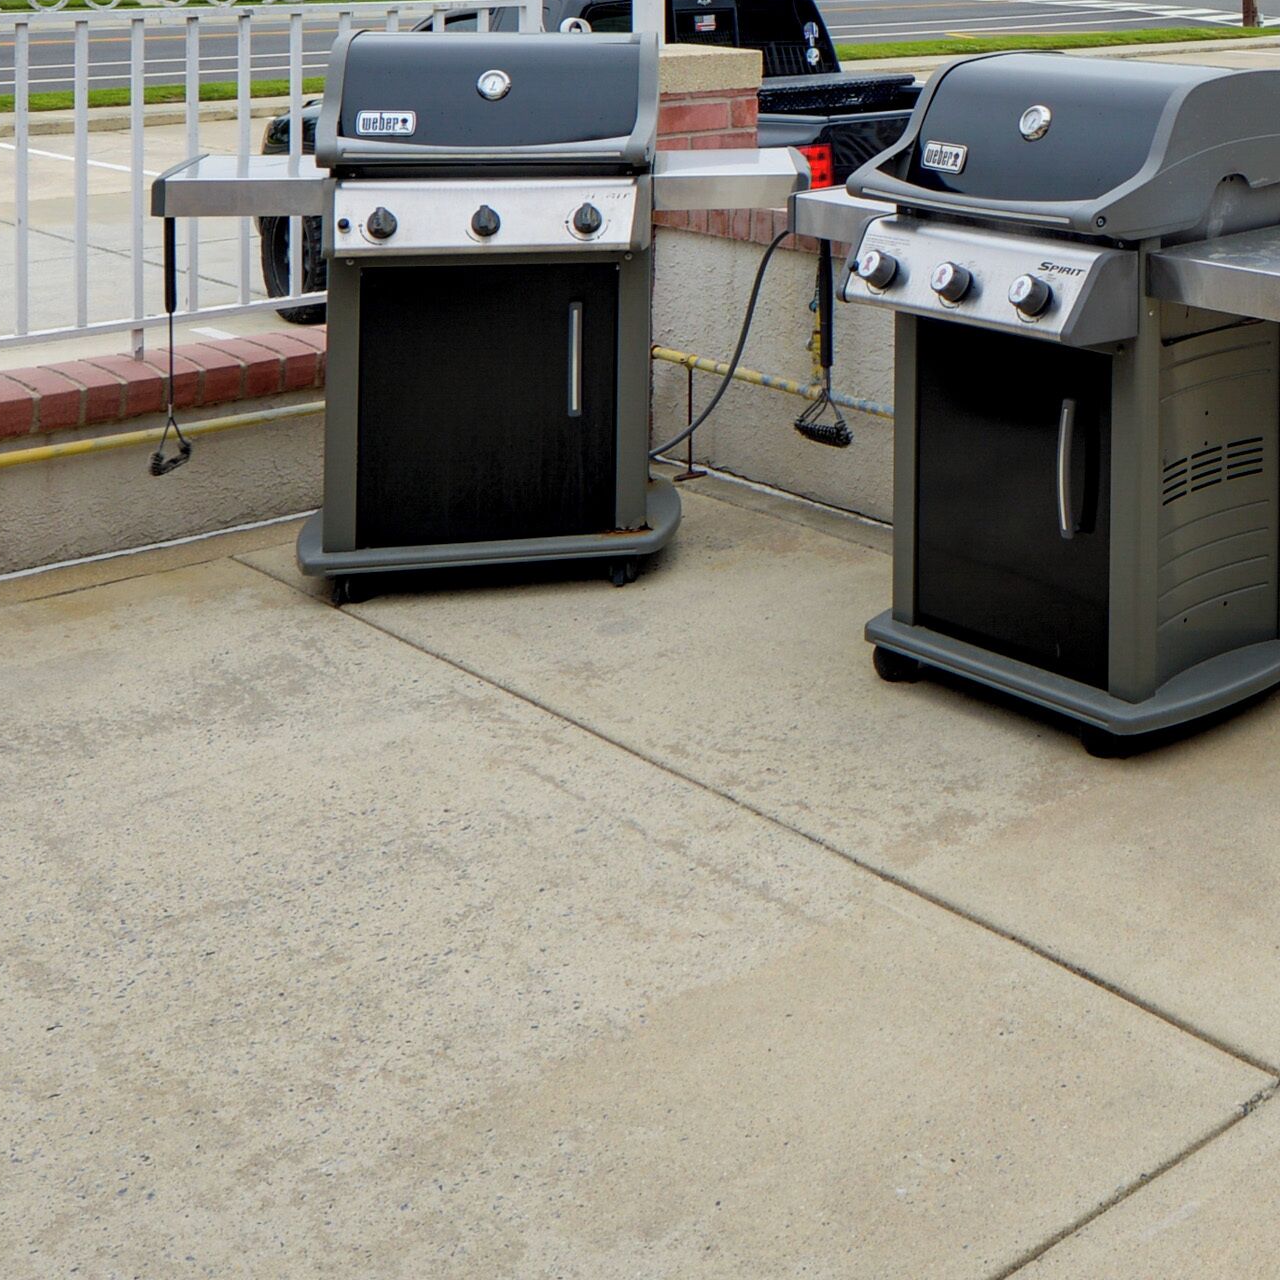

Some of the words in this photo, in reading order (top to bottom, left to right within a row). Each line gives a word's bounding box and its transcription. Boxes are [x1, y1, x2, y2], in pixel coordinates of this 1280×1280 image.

[361, 112, 399, 132] weber
[925, 144, 953, 166] weber
[1037, 261, 1087, 276] SPIRIT
